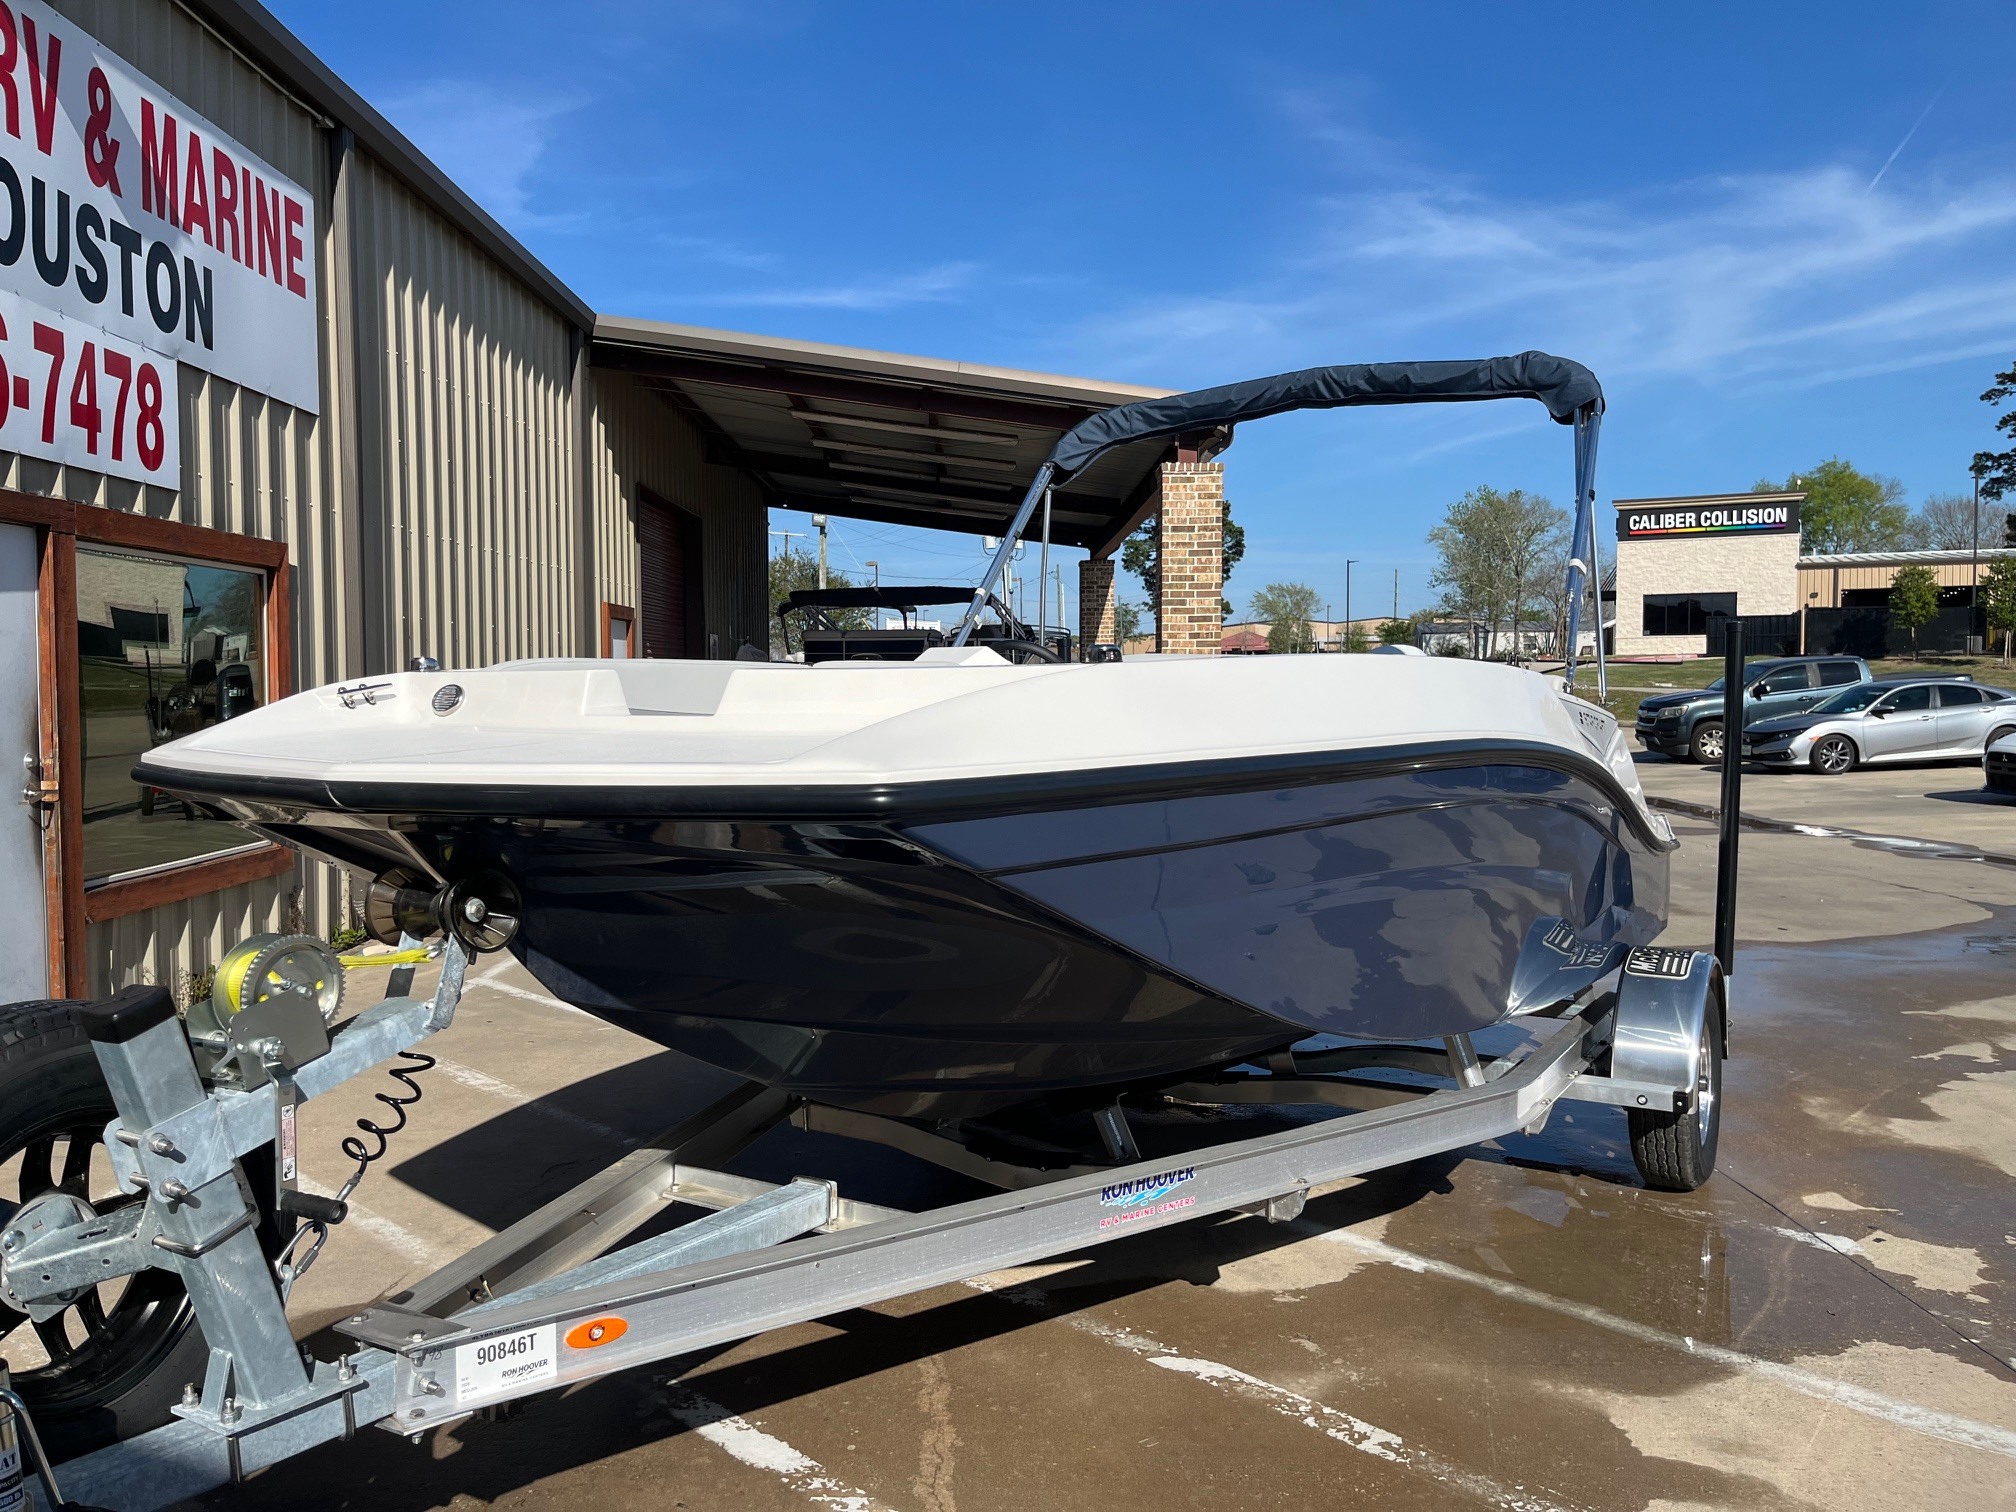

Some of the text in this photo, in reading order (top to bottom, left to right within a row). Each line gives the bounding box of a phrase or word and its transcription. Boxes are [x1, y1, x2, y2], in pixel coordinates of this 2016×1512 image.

[84, 66, 122, 199] &
[140, 97, 306, 300] MARINE
[0, 312, 164, 472] -7478
[1629, 507, 1787, 530] CALIBER COLLISION
[1101, 1167, 1194, 1201] RON HOOVER
[1100, 1196, 1195, 1228] RV & MARINE CENTERS
[477, 1333, 537, 1365] 90846T
[501, 1358, 548, 1379] RON HOOVER
